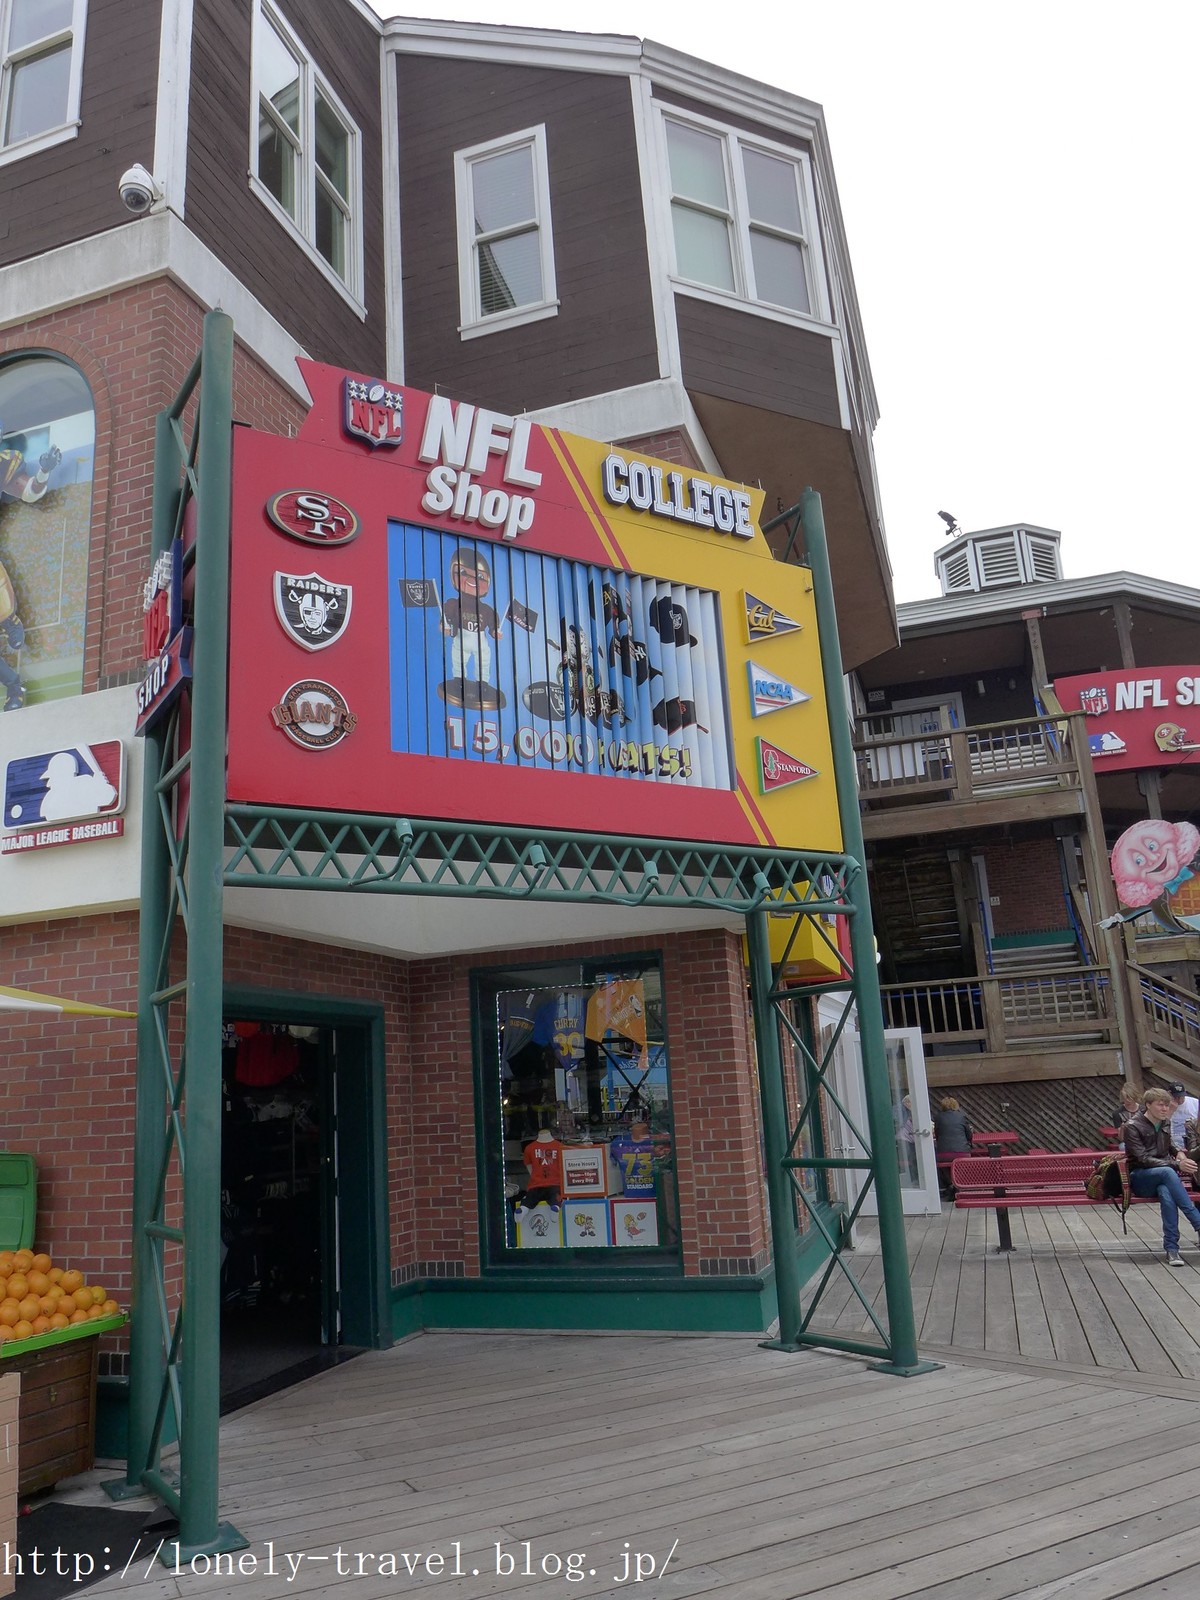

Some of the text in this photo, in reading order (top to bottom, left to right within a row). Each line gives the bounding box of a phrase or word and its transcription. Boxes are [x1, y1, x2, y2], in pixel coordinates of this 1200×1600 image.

[351, 399, 401, 439] NFL
[418, 394, 543, 490] NFL
[422, 465, 535, 541] Shop
[602, 453, 754, 539] COLLEGE
[286, 577, 343, 597] RAIDERS
[750, 604, 776, 632] Cal
[138, 654, 169, 715] SHOP
[755, 679, 794, 701] NCAA
[1115, 678, 1169, 712] NFL
[273, 701, 358, 734] GIANTS
[1082, 697, 1108, 713] NFL
[777, 763, 811, 775] STANFORD
[2, 820, 118, 851] MAJOR LEAGUE BASEBALL
[554, 1017, 579, 1030] CURRY
[552, 1032, 580, 1057] 30
[622, 1152, 653, 1177] 73
